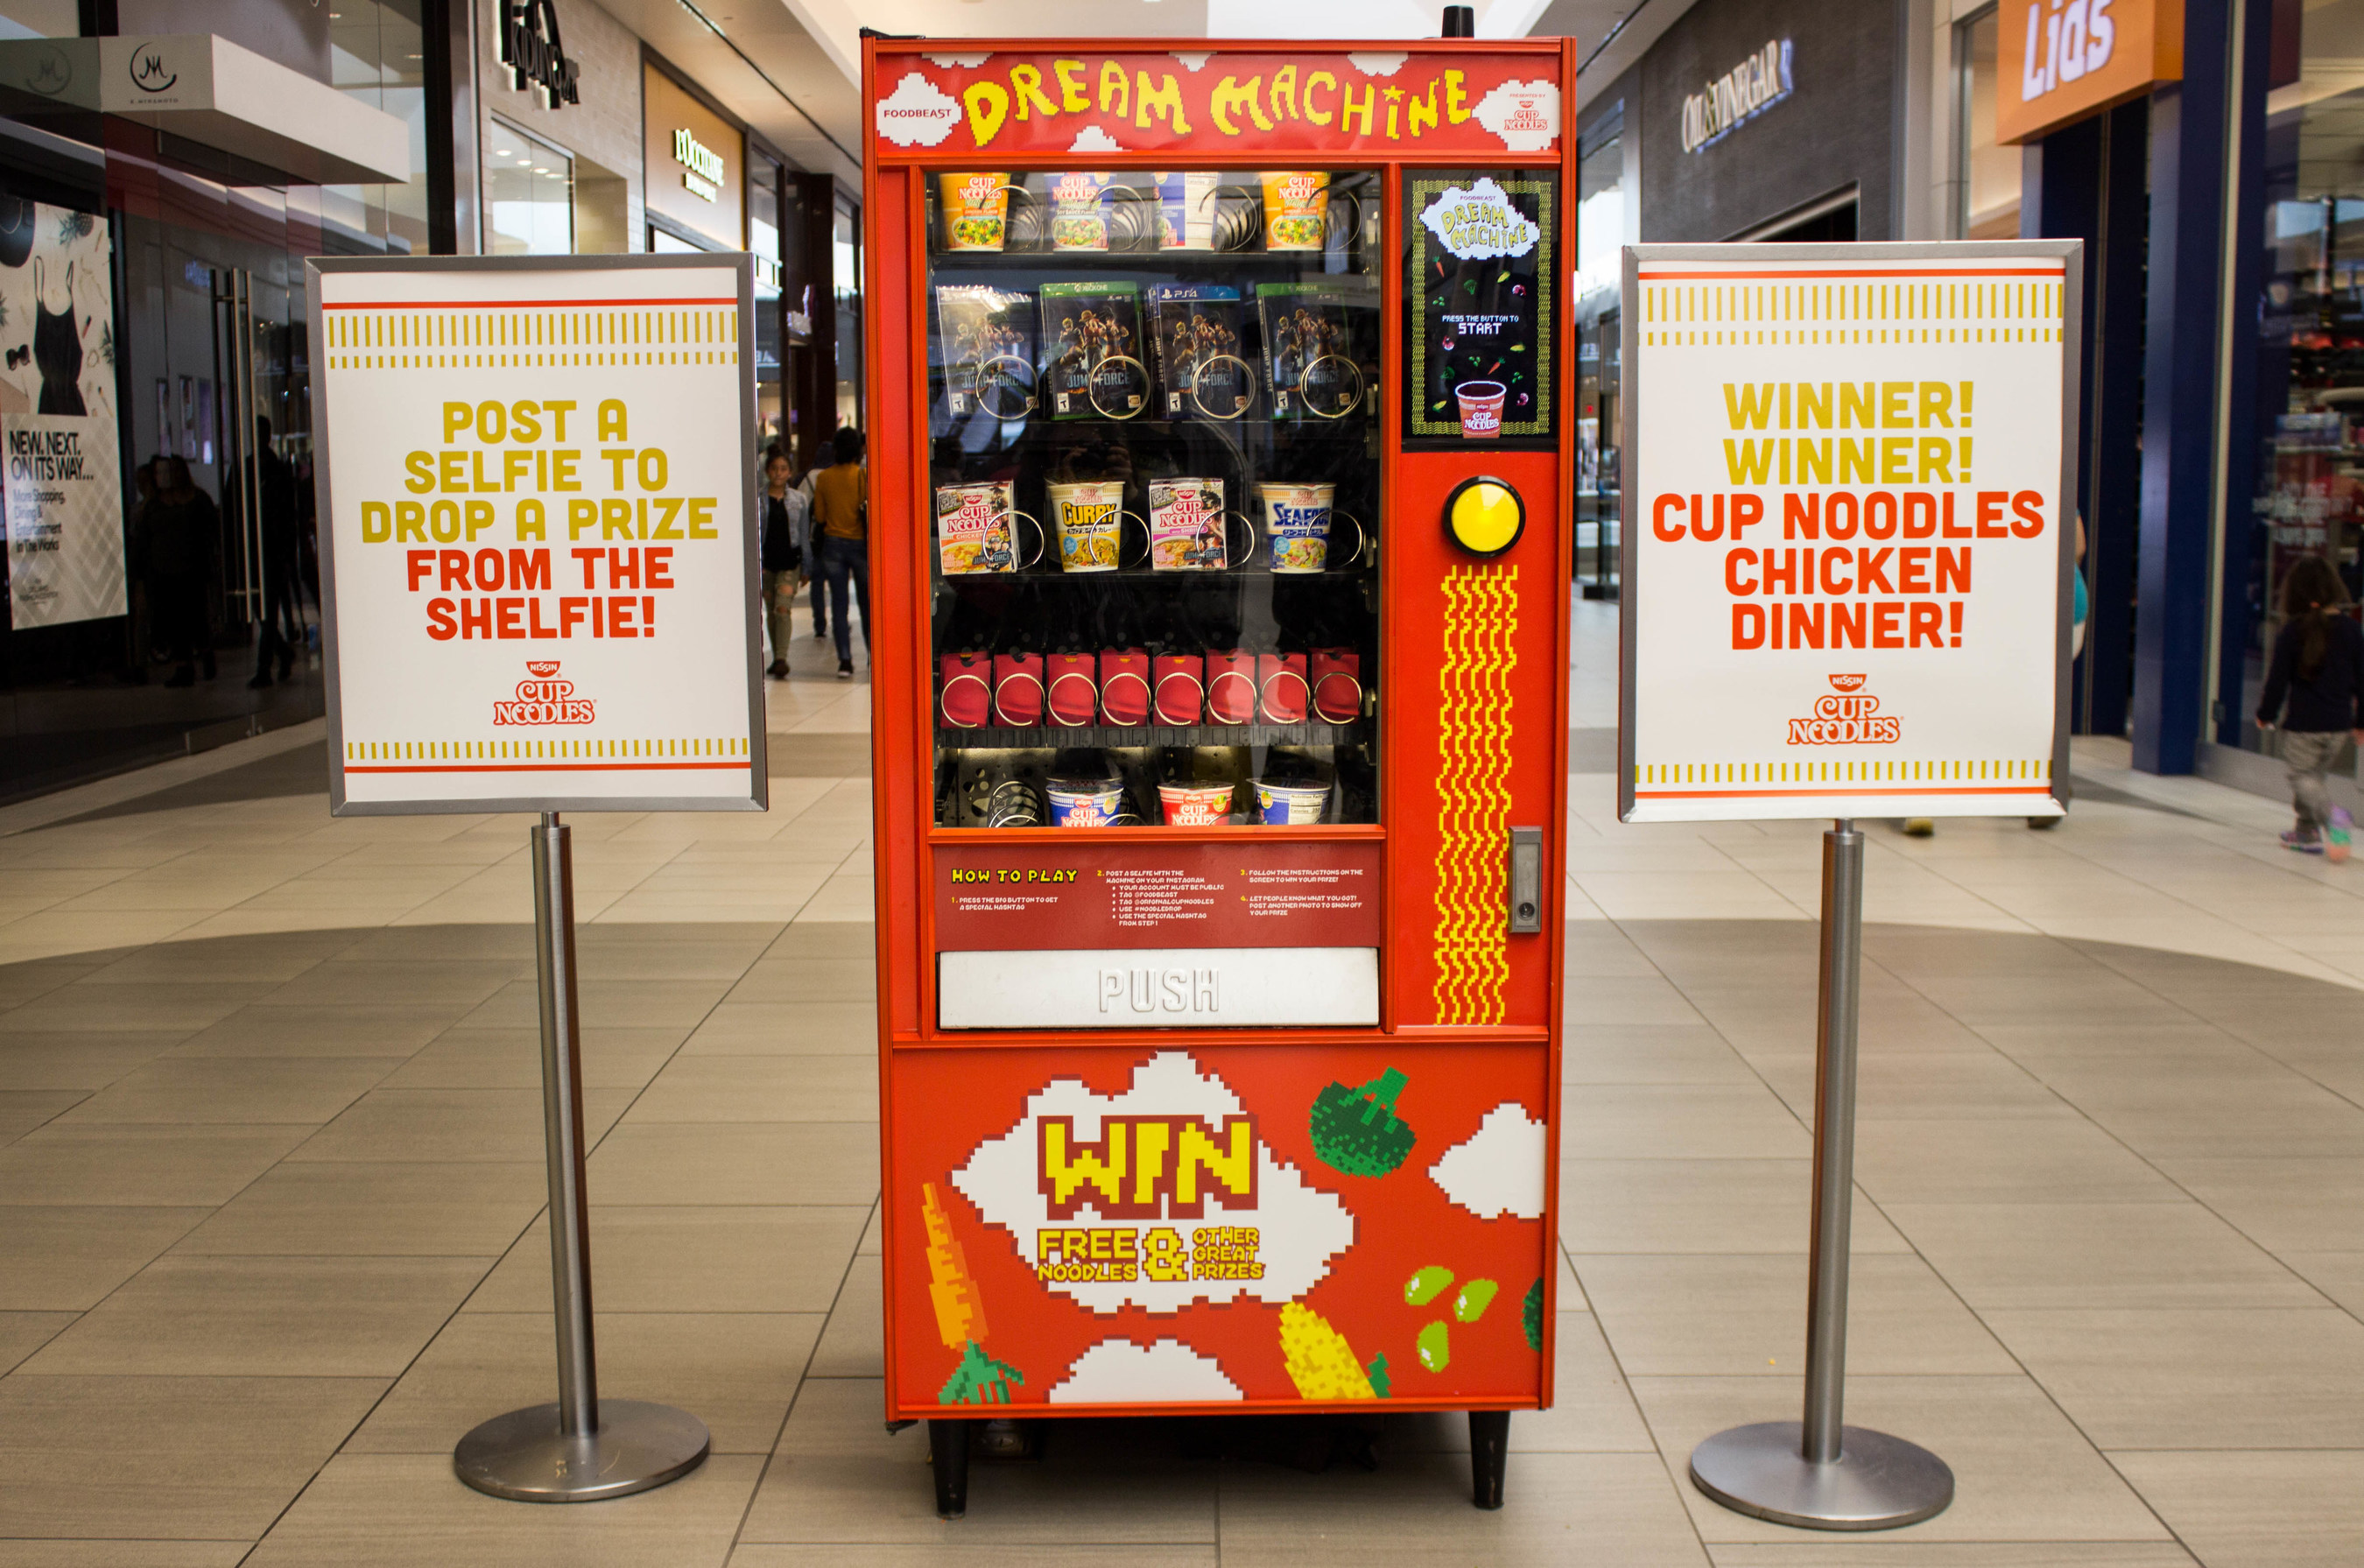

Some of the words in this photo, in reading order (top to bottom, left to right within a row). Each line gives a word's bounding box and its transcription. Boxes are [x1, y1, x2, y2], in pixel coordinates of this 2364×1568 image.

[2021, 0, 2114, 102] Lids
[883, 108, 952, 119] FOODBEAST
[963, 59, 1192, 148] DREAM
[1514, 110, 1539, 120] CUP
[1504, 119, 1547, 130] NOODLES
[968, 177, 996, 188] CUP
[1060, 177, 1091, 188] CUP
[1288, 177, 1315, 188] CUP
[1441, 202, 1509, 235] DREAM
[1174, 290, 1197, 299] PS4
[1458, 322, 1502, 334] START
[1097, 373, 1130, 386] FORCE
[1473, 411, 1492, 420] CUP
[1722, 380, 1974, 430] WINNER!
[443, 399, 577, 445] POST
[597, 398, 628, 443] A
[1464, 418, 1499, 430] NOODLES
[10, 430, 44, 455] NEW.
[46, 432, 81, 456] NEXT.
[11, 457, 33, 481] ON
[35, 457, 56, 481] ITS
[405, 448, 582, 495] SELFIE
[601, 447, 668, 492] TO
[1722, 436, 1974, 486] WINNER!
[959, 505, 990, 519] CUP
[1060, 502, 1117, 527] CURRY
[1171, 500, 1203, 514] CUP
[1652, 492, 1764, 542] CUP
[1784, 490, 2045, 541] NOODLES
[361, 499, 496, 544] DROP
[516, 498, 546, 542] A
[568, 497, 719, 541] PRIZE
[406, 548, 552, 592] FROM
[571, 546, 675, 590] THE
[1725, 546, 1972, 596] CHICKEN
[426, 595, 656, 642] SHELFIE!
[1731, 601, 1965, 650] DINNER!
[530, 663, 558, 673] NISSIN
[516, 680, 573, 702] CUP
[1833, 675, 1863, 687] NISSIN
[493, 700, 595, 726] NOODLES
[1814, 694, 1880, 720] CUP
[1786, 716, 1901, 745] NOODLES
[1070, 808, 1099, 819] CUP
[1180, 805, 1208, 815] CUP
[952, 868, 990, 883] HOW
[997, 868, 1021, 883] TO
[1028, 868, 1078, 883] PLAY
[1099, 968, 1220, 1013] PUSH
[1043, 1119, 1254, 1208] WIN
[1038, 1228, 1138, 1262] FREE
[1143, 1227, 1189, 1282] &
[1193, 1227, 1259, 1244] OTHER
[1193, 1244, 1259, 1262] GREAT
[1038, 1263, 1138, 1283] NOODLES
[1193, 1262, 1266, 1280] PRIZES
